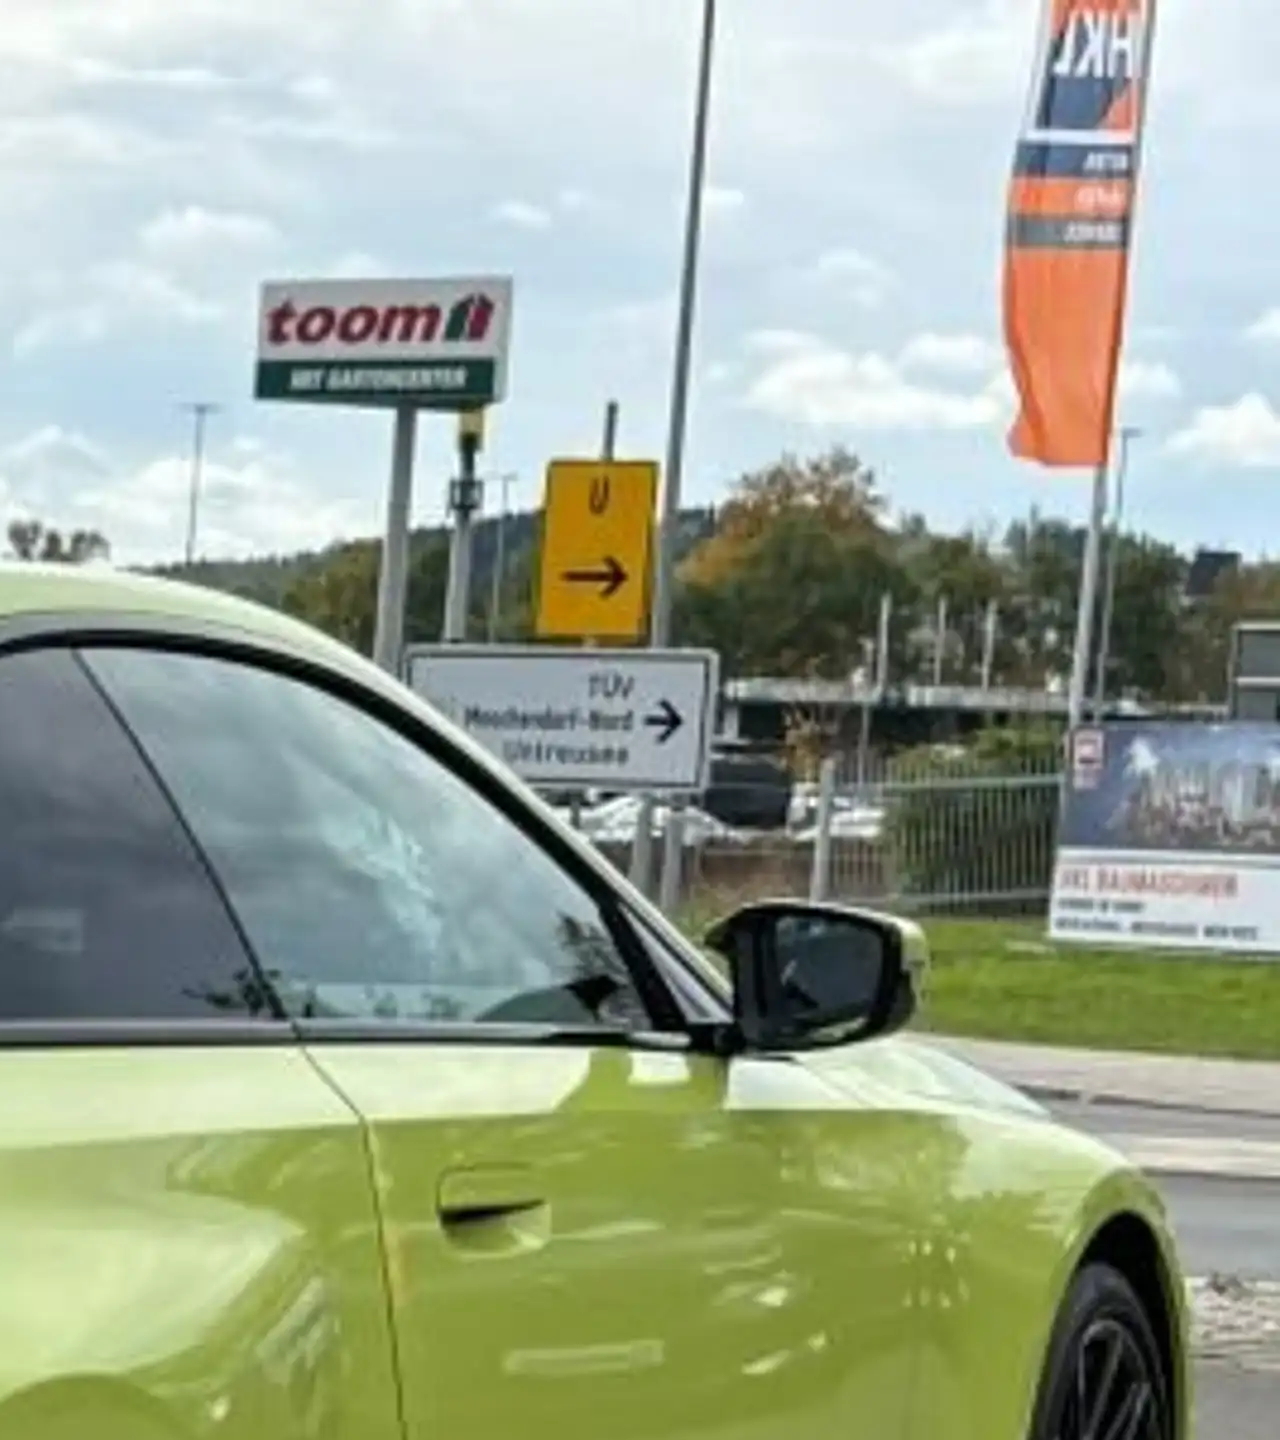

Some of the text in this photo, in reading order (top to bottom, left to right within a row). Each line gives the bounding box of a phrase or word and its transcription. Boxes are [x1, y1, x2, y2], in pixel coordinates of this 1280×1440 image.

[267, 299, 442, 345] toom
[589, 475, 609, 514] U
[589, 672, 635, 699] TÜV
